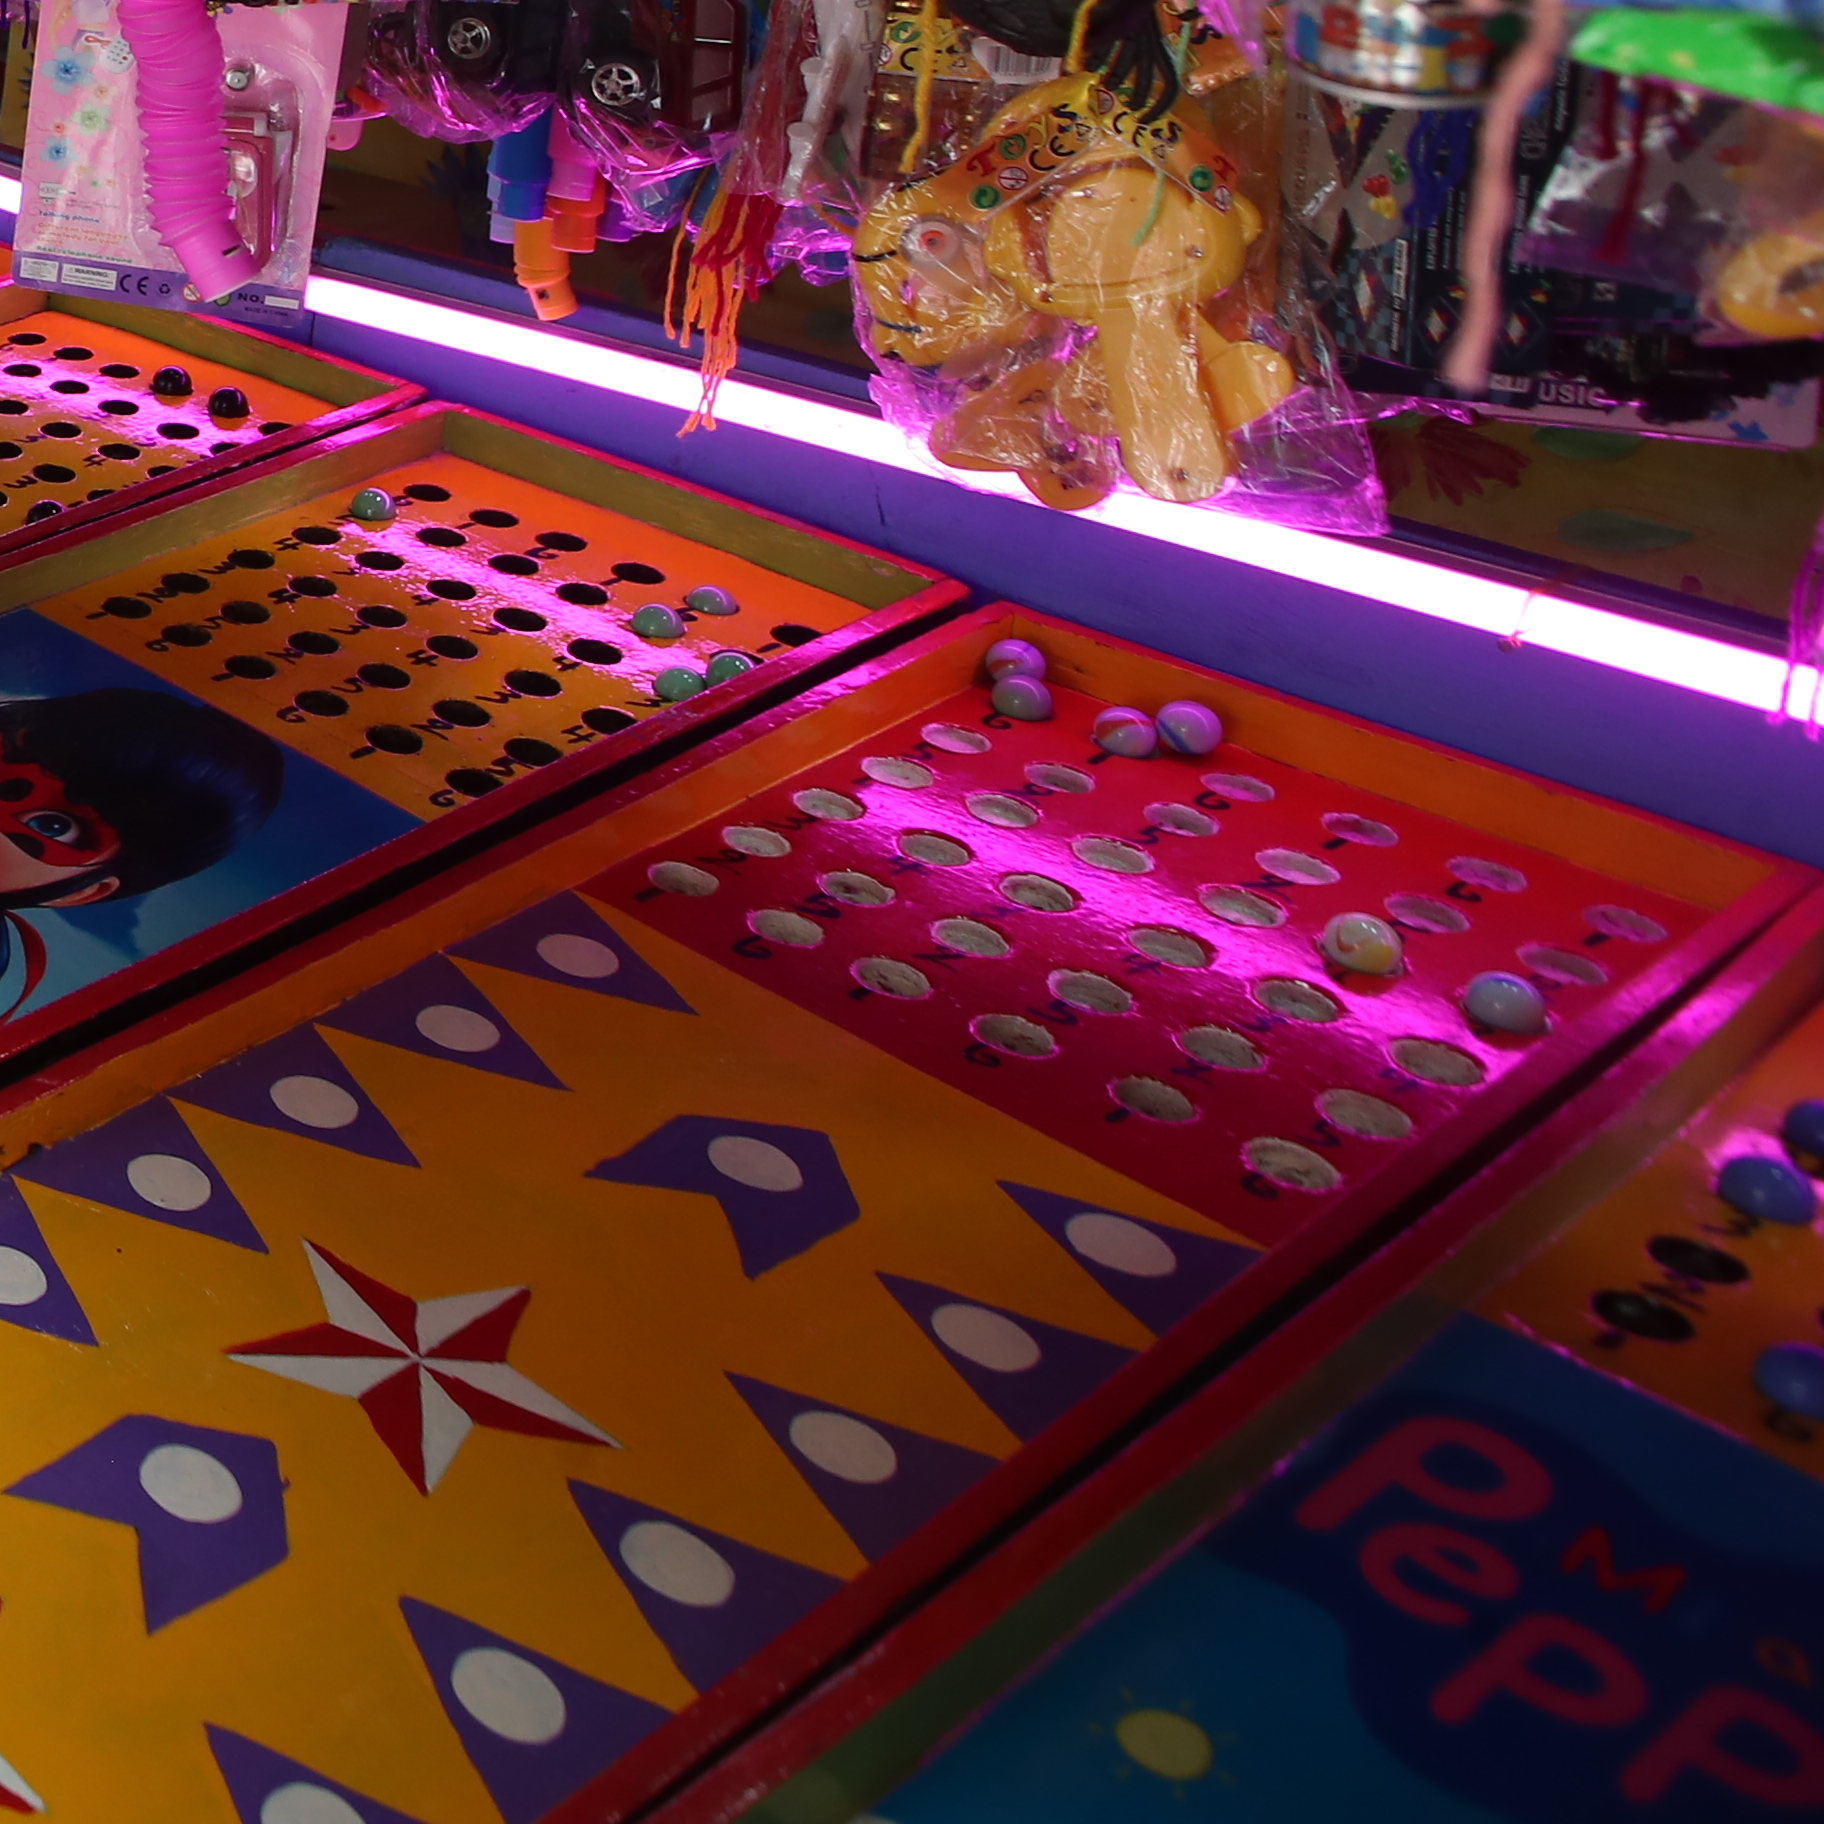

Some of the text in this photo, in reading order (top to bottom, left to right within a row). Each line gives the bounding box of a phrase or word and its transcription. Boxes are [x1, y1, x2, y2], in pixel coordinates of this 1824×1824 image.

[70, 214, 101, 224] phone
[119, 273, 149, 296] CE
[237, 292, 264, 305] NO.
